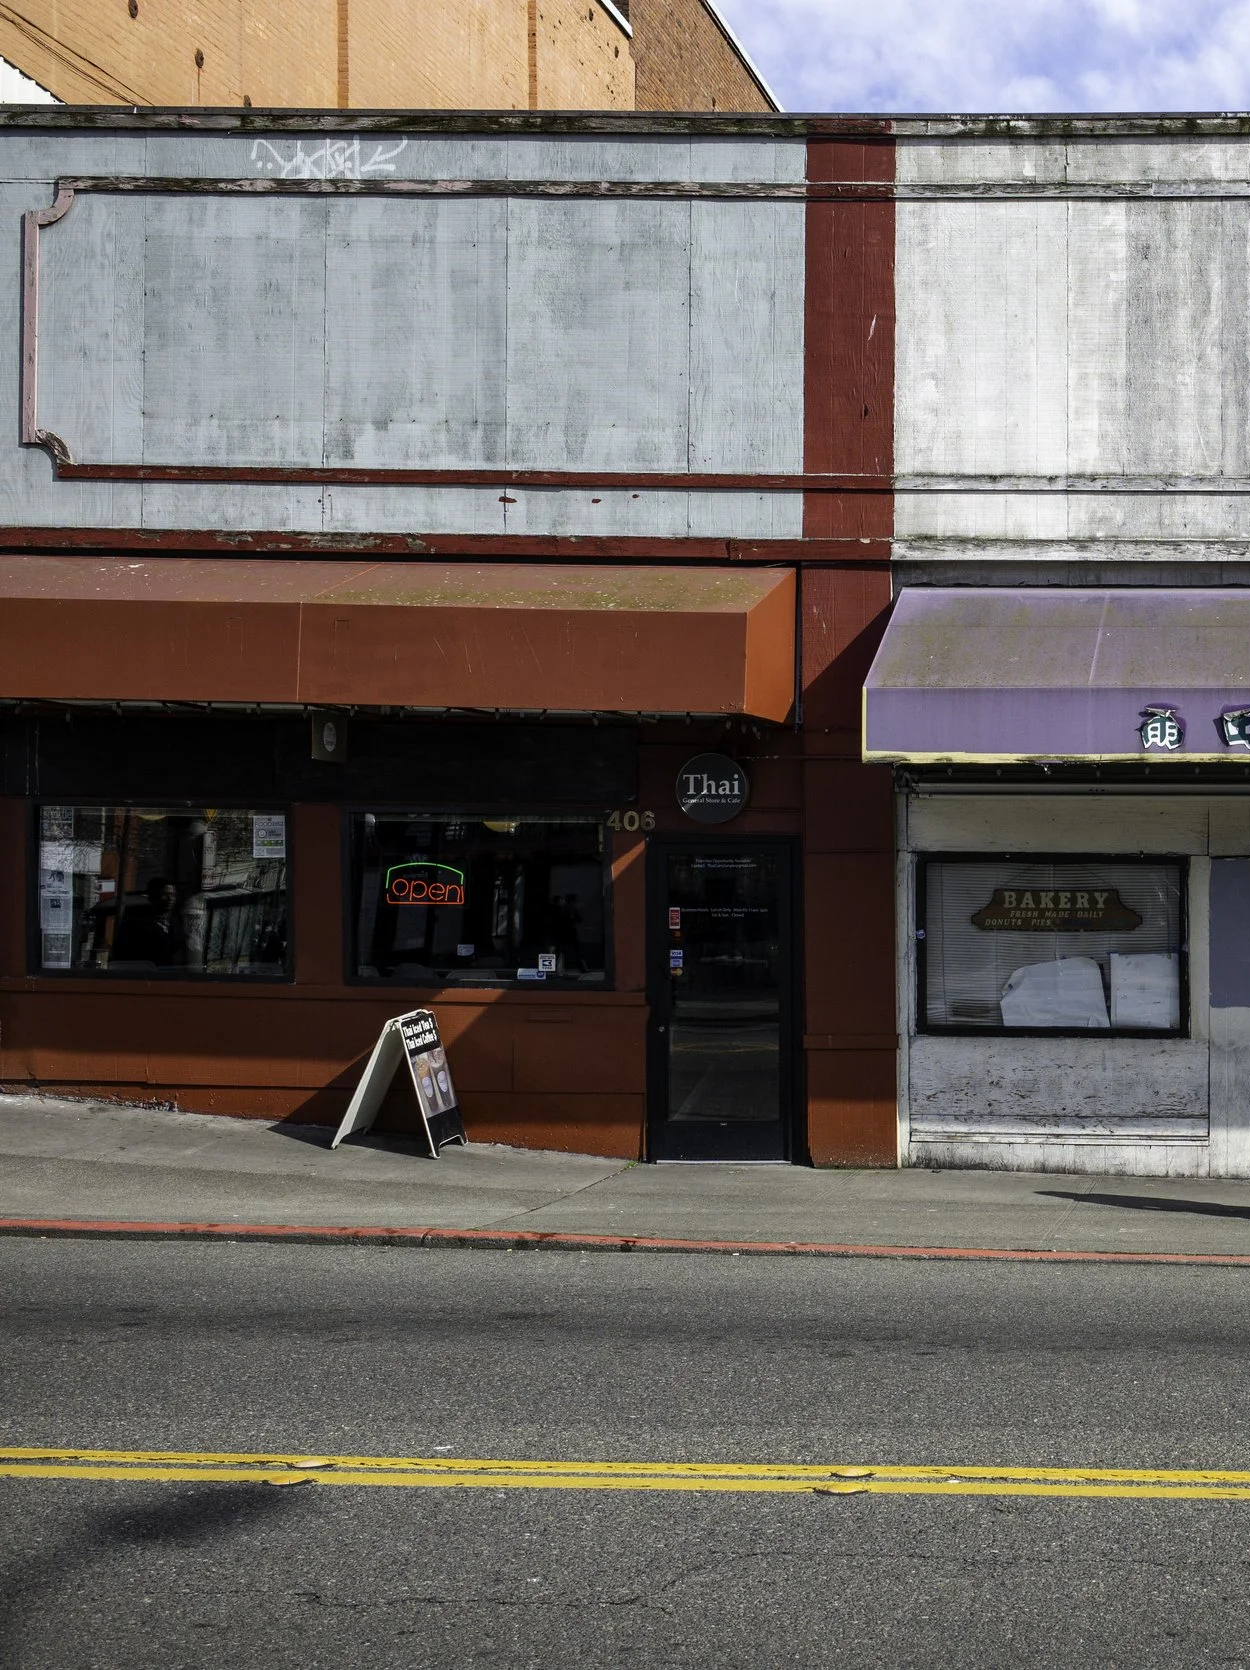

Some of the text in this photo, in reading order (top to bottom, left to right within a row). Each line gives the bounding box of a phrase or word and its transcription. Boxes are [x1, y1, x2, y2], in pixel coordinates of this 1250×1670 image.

[682, 773, 741, 795] Thai
[607, 810, 655, 831] 406
[392, 877, 461, 903] open
[1003, 891, 1109, 909] BAKERY
[984, 918, 1051, 926] DONUTS PIES
[1010, 910, 1104, 918] FRESH MADE DAILY
[421, 1020, 430, 1030] Tea
